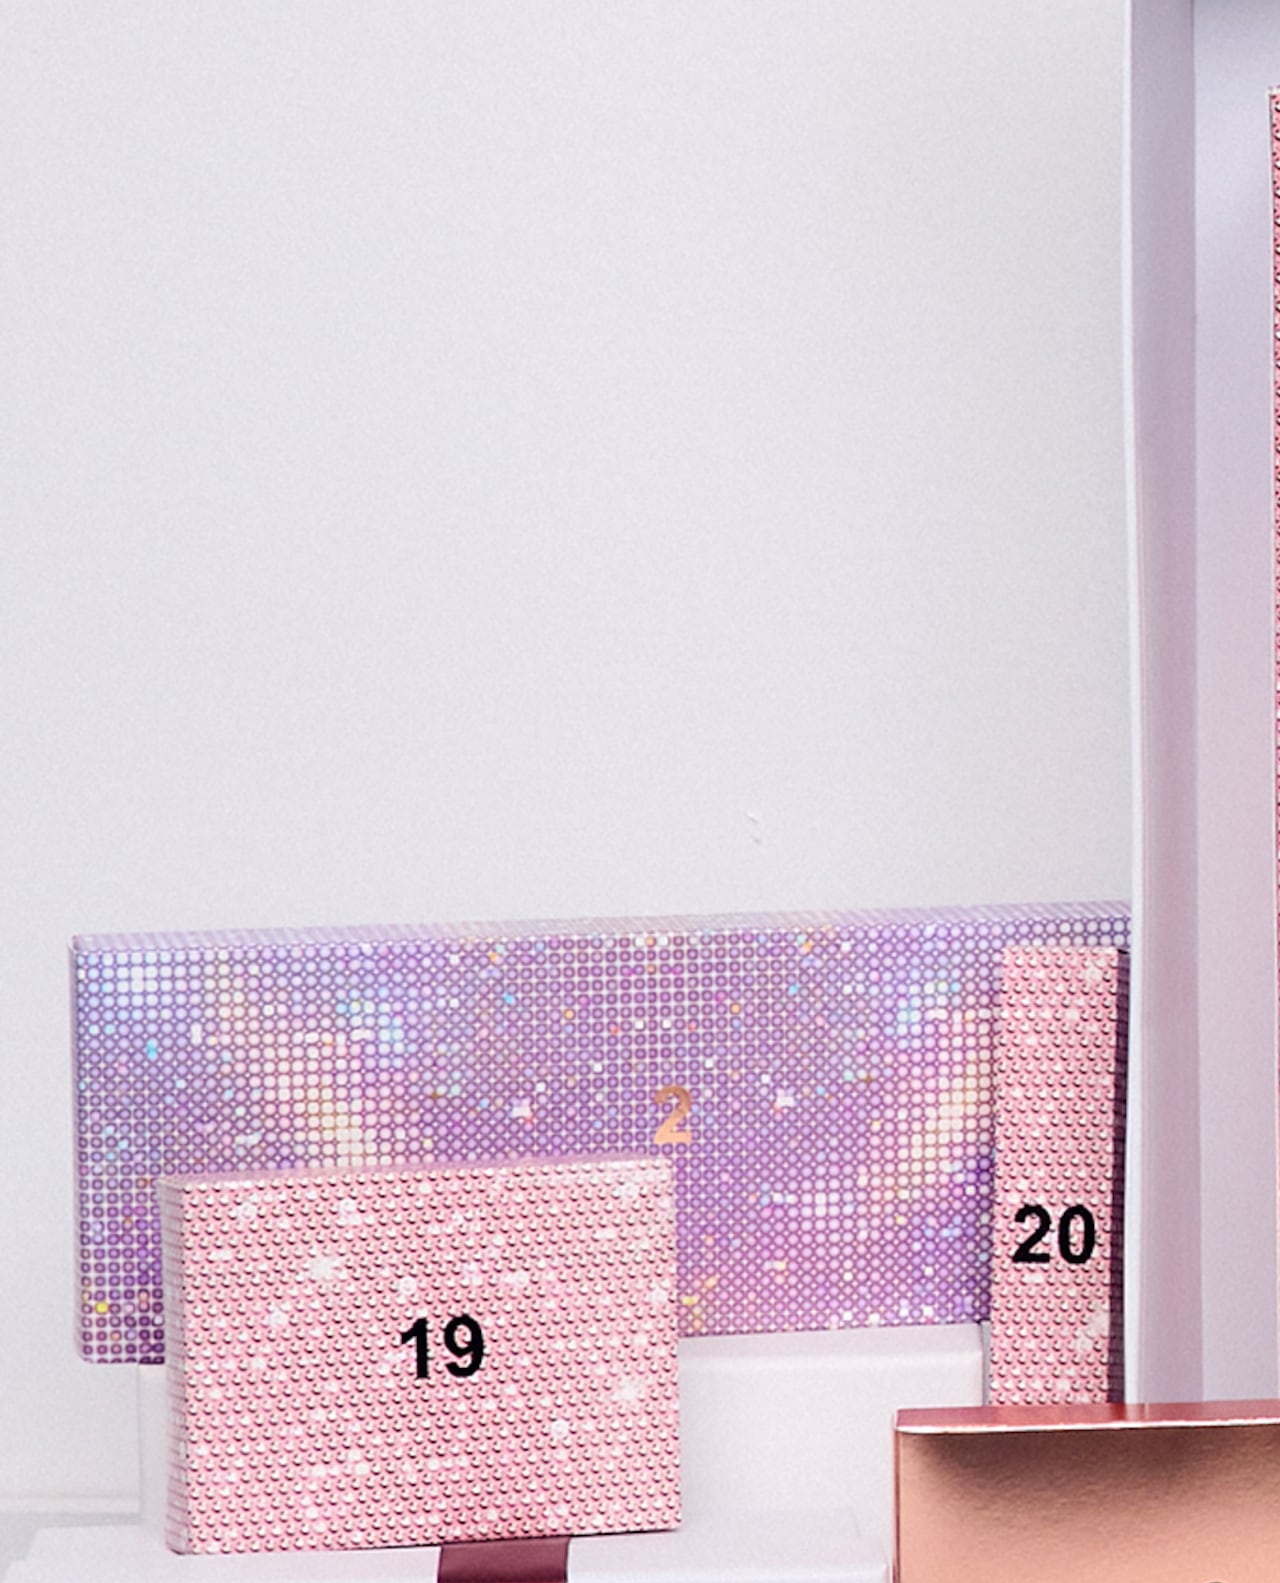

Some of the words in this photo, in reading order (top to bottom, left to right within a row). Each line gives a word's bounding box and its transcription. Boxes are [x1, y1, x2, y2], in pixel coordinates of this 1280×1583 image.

[653, 1084, 693, 1145] 2
[1011, 1203, 1097, 1265] 20
[400, 1313, 486, 1379] 19
